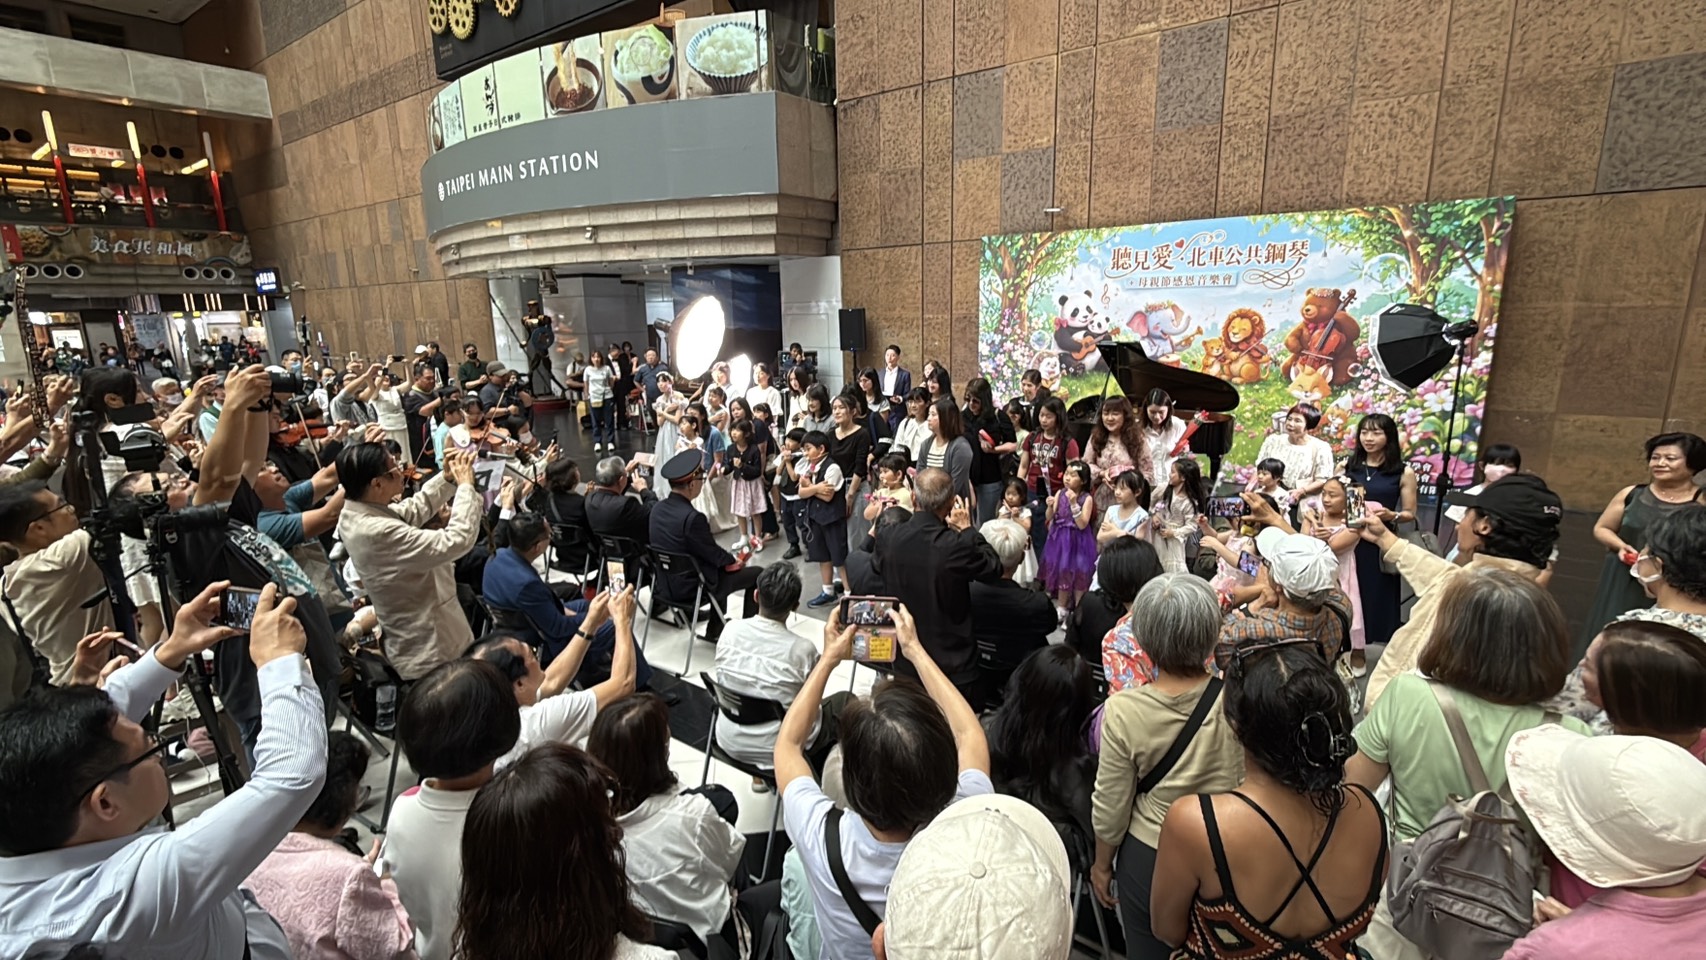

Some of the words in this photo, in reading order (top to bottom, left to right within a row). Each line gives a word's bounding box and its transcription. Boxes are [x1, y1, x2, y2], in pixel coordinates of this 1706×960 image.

[446, 172, 475, 197] TAIPEI
[478, 163, 514, 188] MAIN
[519, 150, 599, 179] STATION
[90, 235, 195, 257] 美食共和國
[1138, 273, 1233, 288] 母親節感恩音樂會
